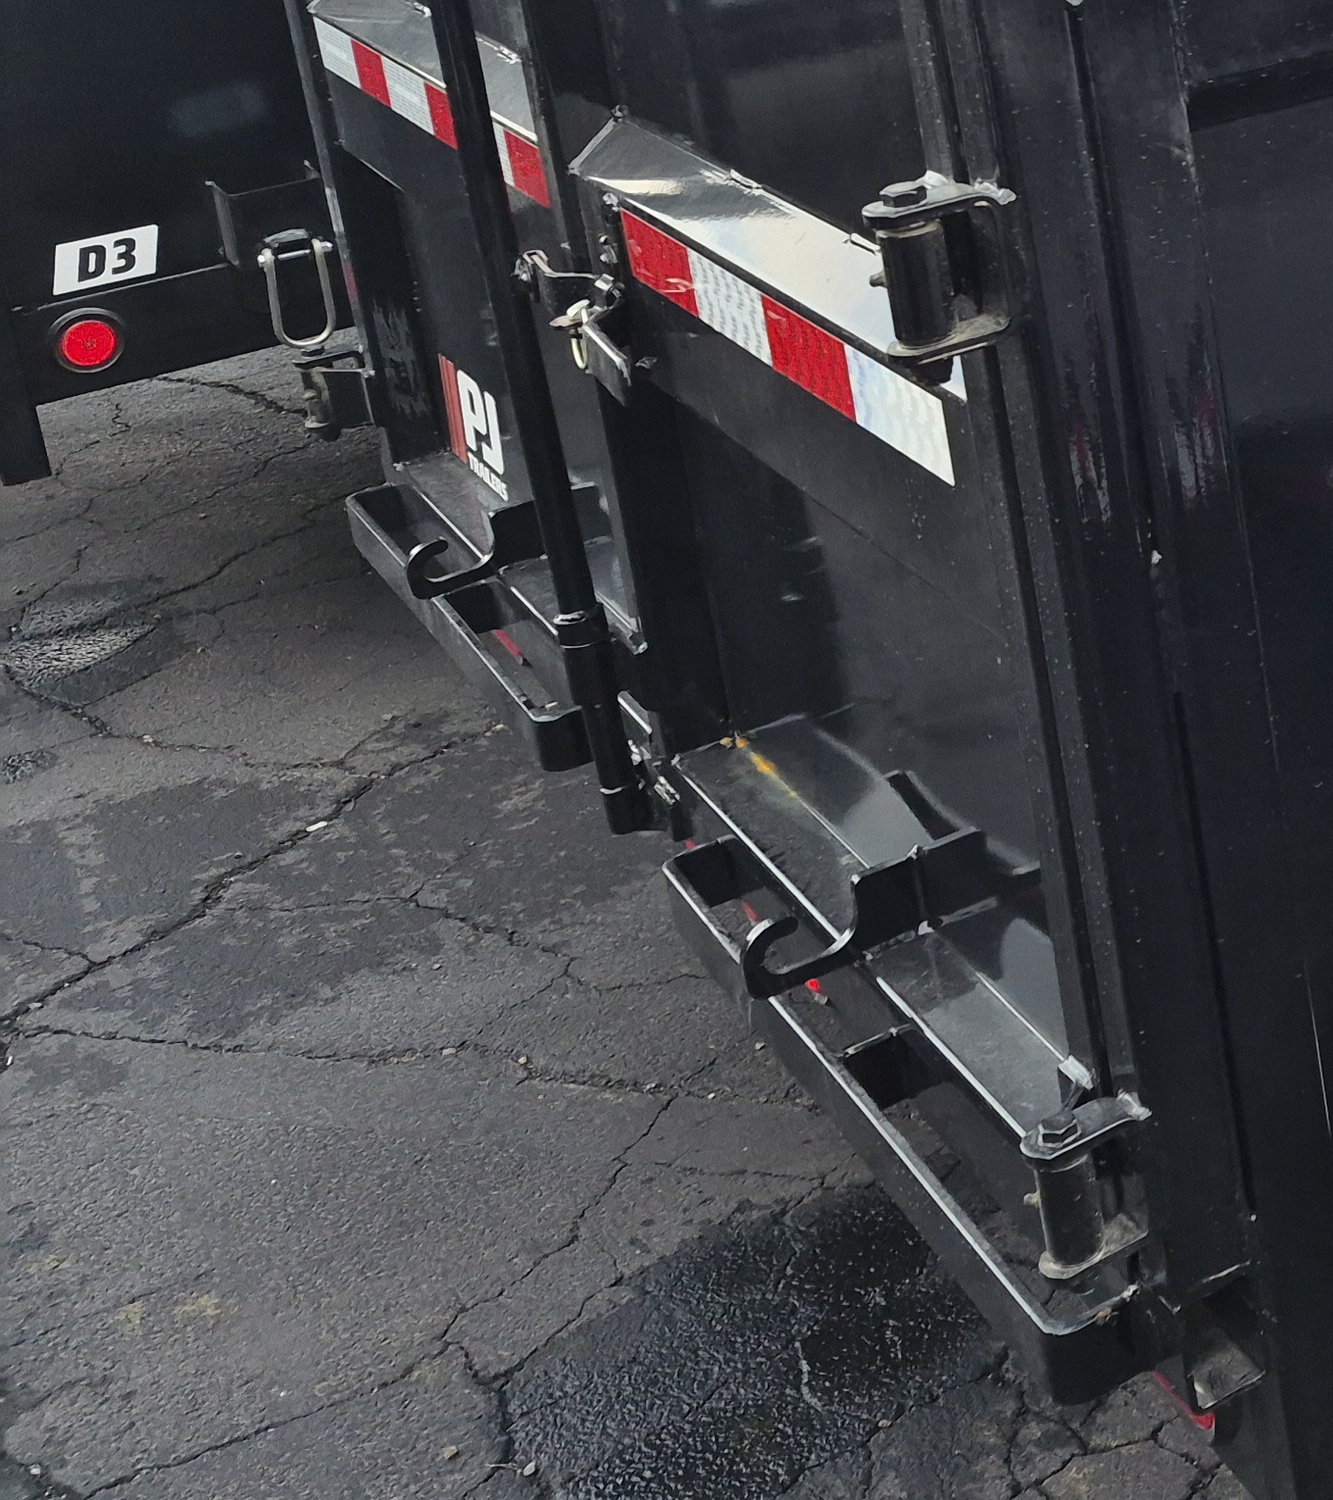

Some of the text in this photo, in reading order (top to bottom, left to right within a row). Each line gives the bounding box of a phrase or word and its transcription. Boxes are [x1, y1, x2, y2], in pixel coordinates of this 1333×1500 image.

[77, 237, 137, 284] D3
[456, 368, 506, 476] PJ
[467, 450, 509, 502] TRAILERS
